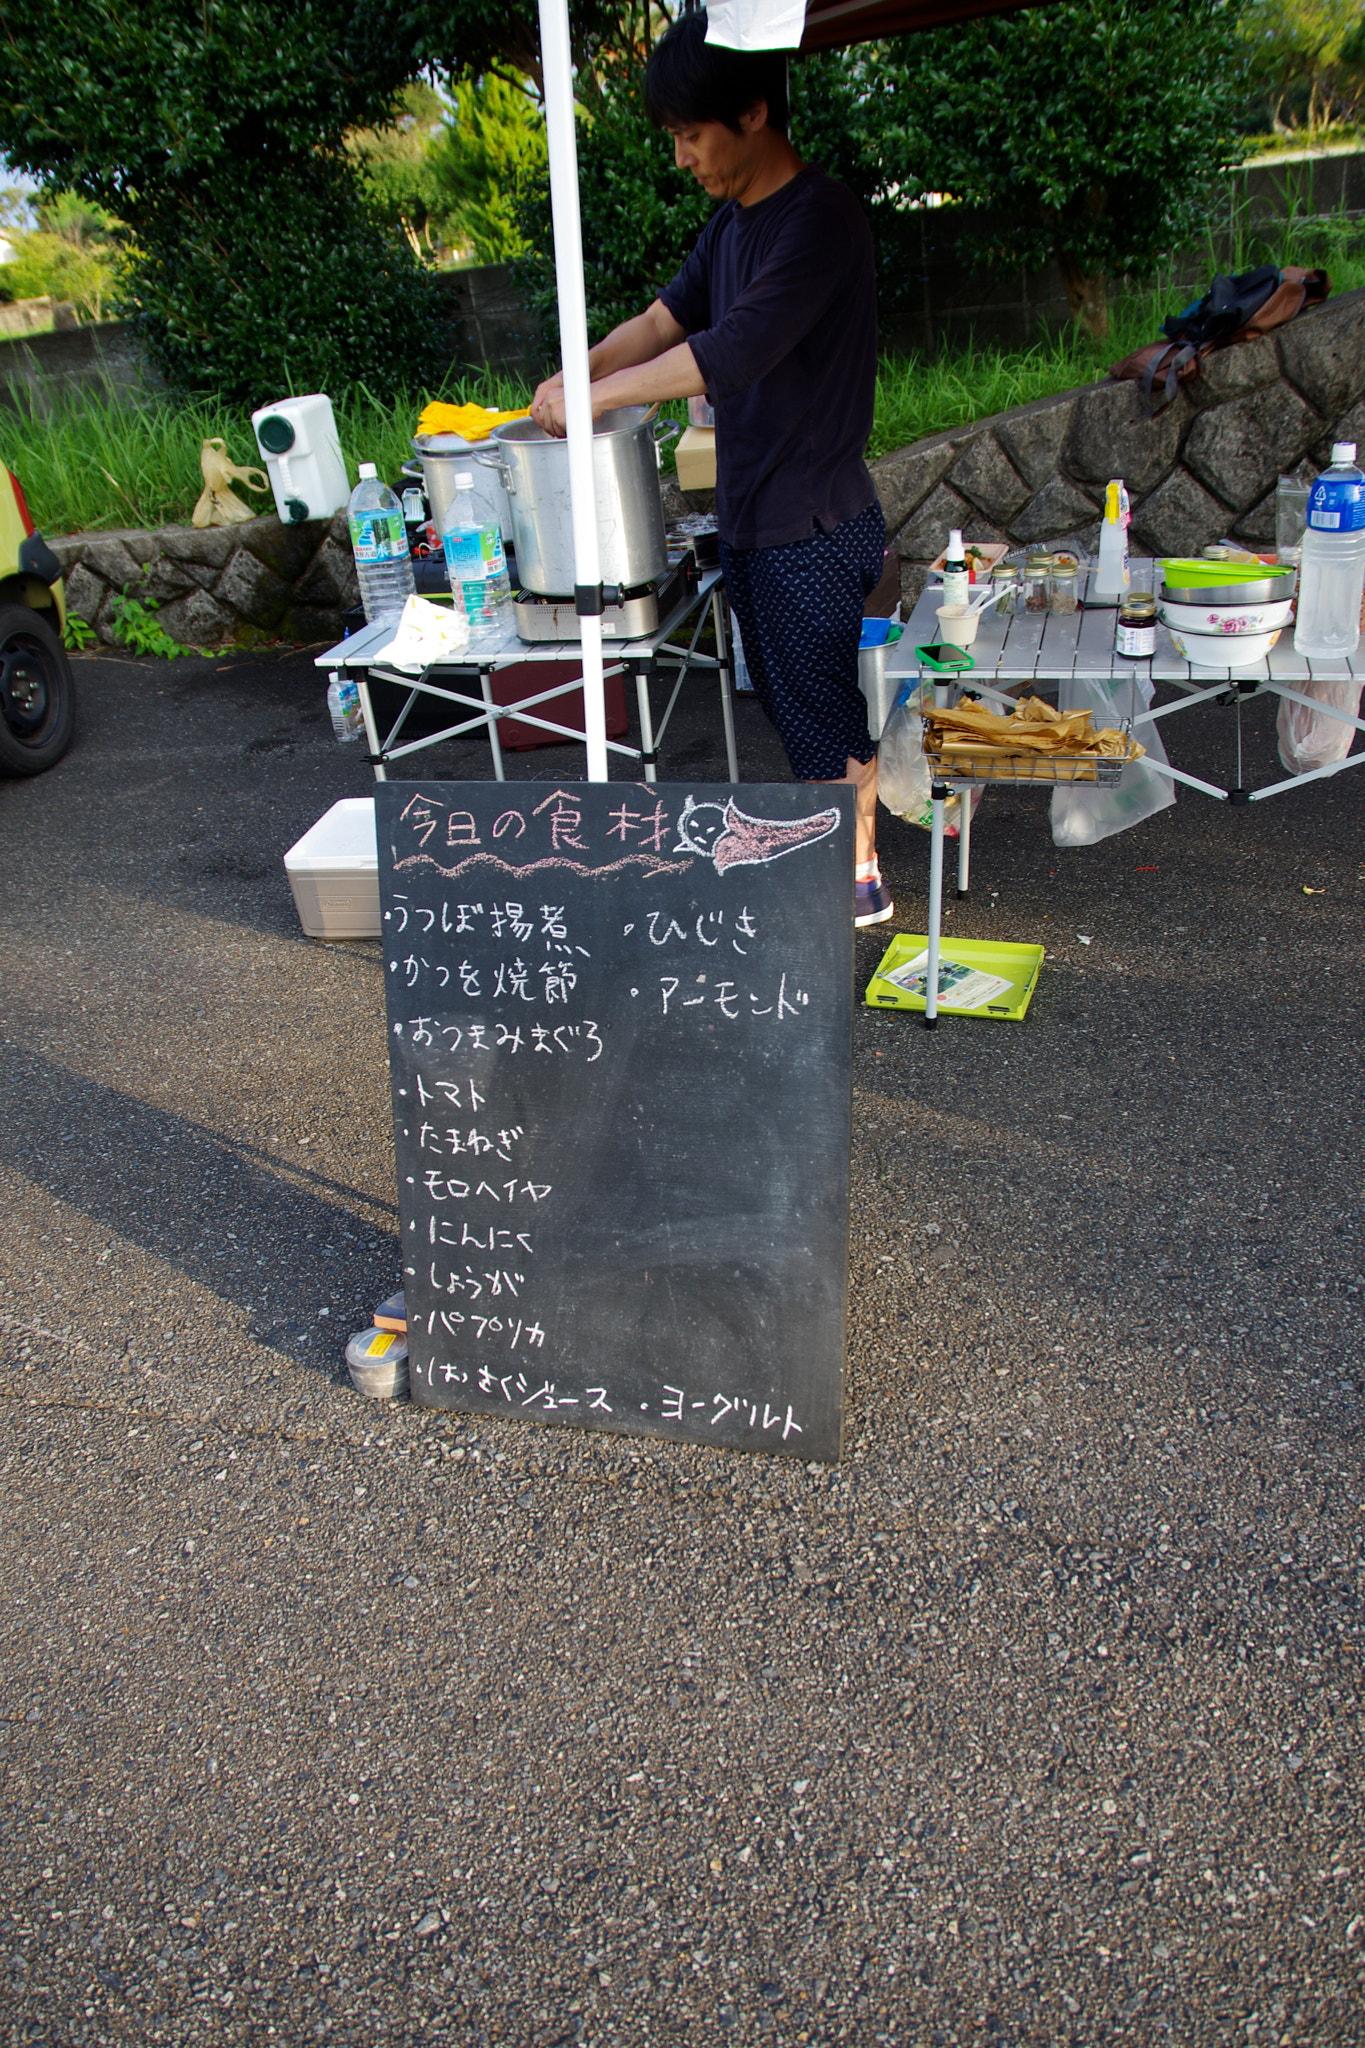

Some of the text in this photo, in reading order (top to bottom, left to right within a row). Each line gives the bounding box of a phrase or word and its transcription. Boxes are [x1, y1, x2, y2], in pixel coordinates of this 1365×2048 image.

[400, 782, 671, 852] 今日の食材
[646, 906, 758, 955] ひじき
[660, 973, 809, 1020] アーモンド
[411, 1016, 604, 1062] おつまみまぐろ
[416, 1074, 486, 1112] トマト
[420, 1121, 524, 1162] たまねぎ
[423, 1170, 552, 1202] モロヘイヤ
[429, 1215, 533, 1253] にんにく
[430, 1262, 525, 1299] しょうが
[427, 1311, 545, 1349] パプリカ
[662, 1385, 803, 1440] ヨーグルト
